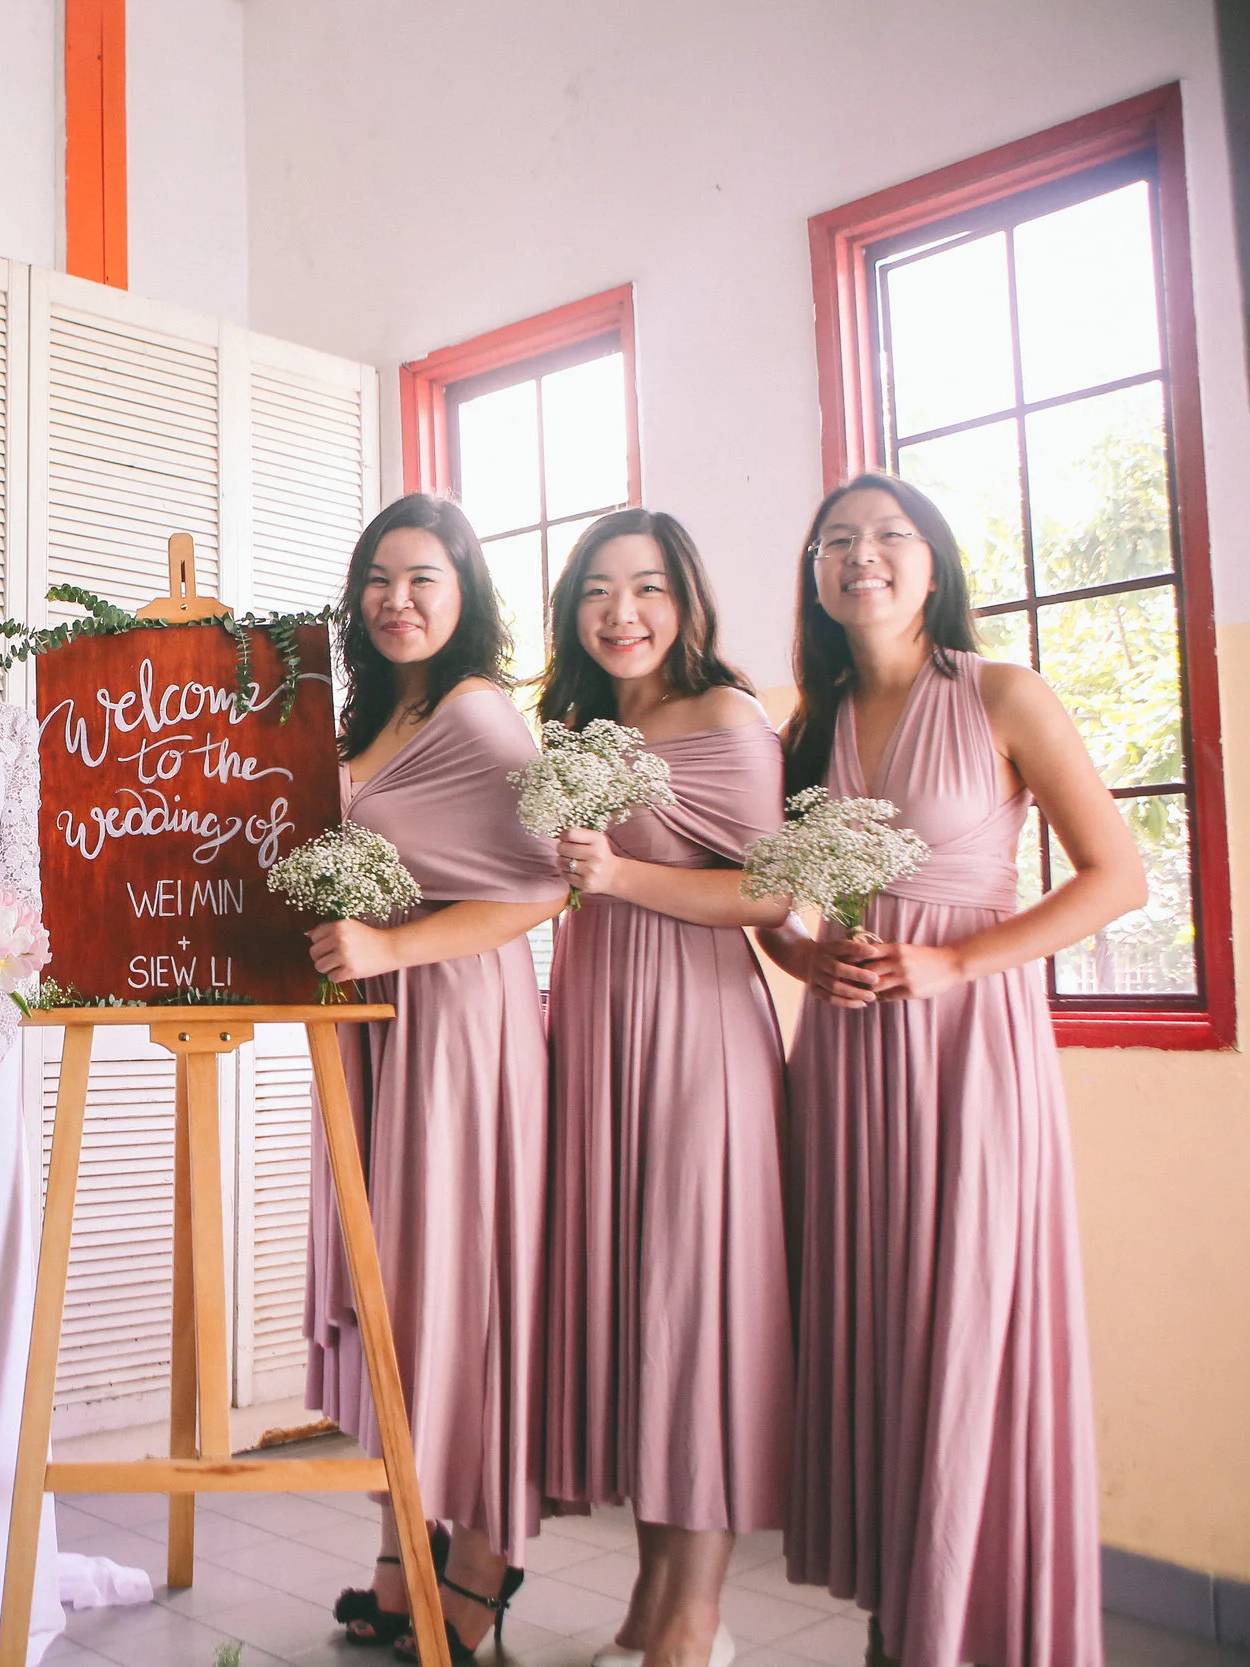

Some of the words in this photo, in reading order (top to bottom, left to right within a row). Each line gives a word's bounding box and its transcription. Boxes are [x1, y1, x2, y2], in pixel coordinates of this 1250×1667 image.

[117, 735, 194, 785] to
[188, 732, 294, 784] the
[245, 797, 296, 869] of
[126, 879, 183, 918] WEI
[189, 878, 244, 918] MIN
[127, 955, 197, 988] SIEW
[210, 956, 232, 987] LI
